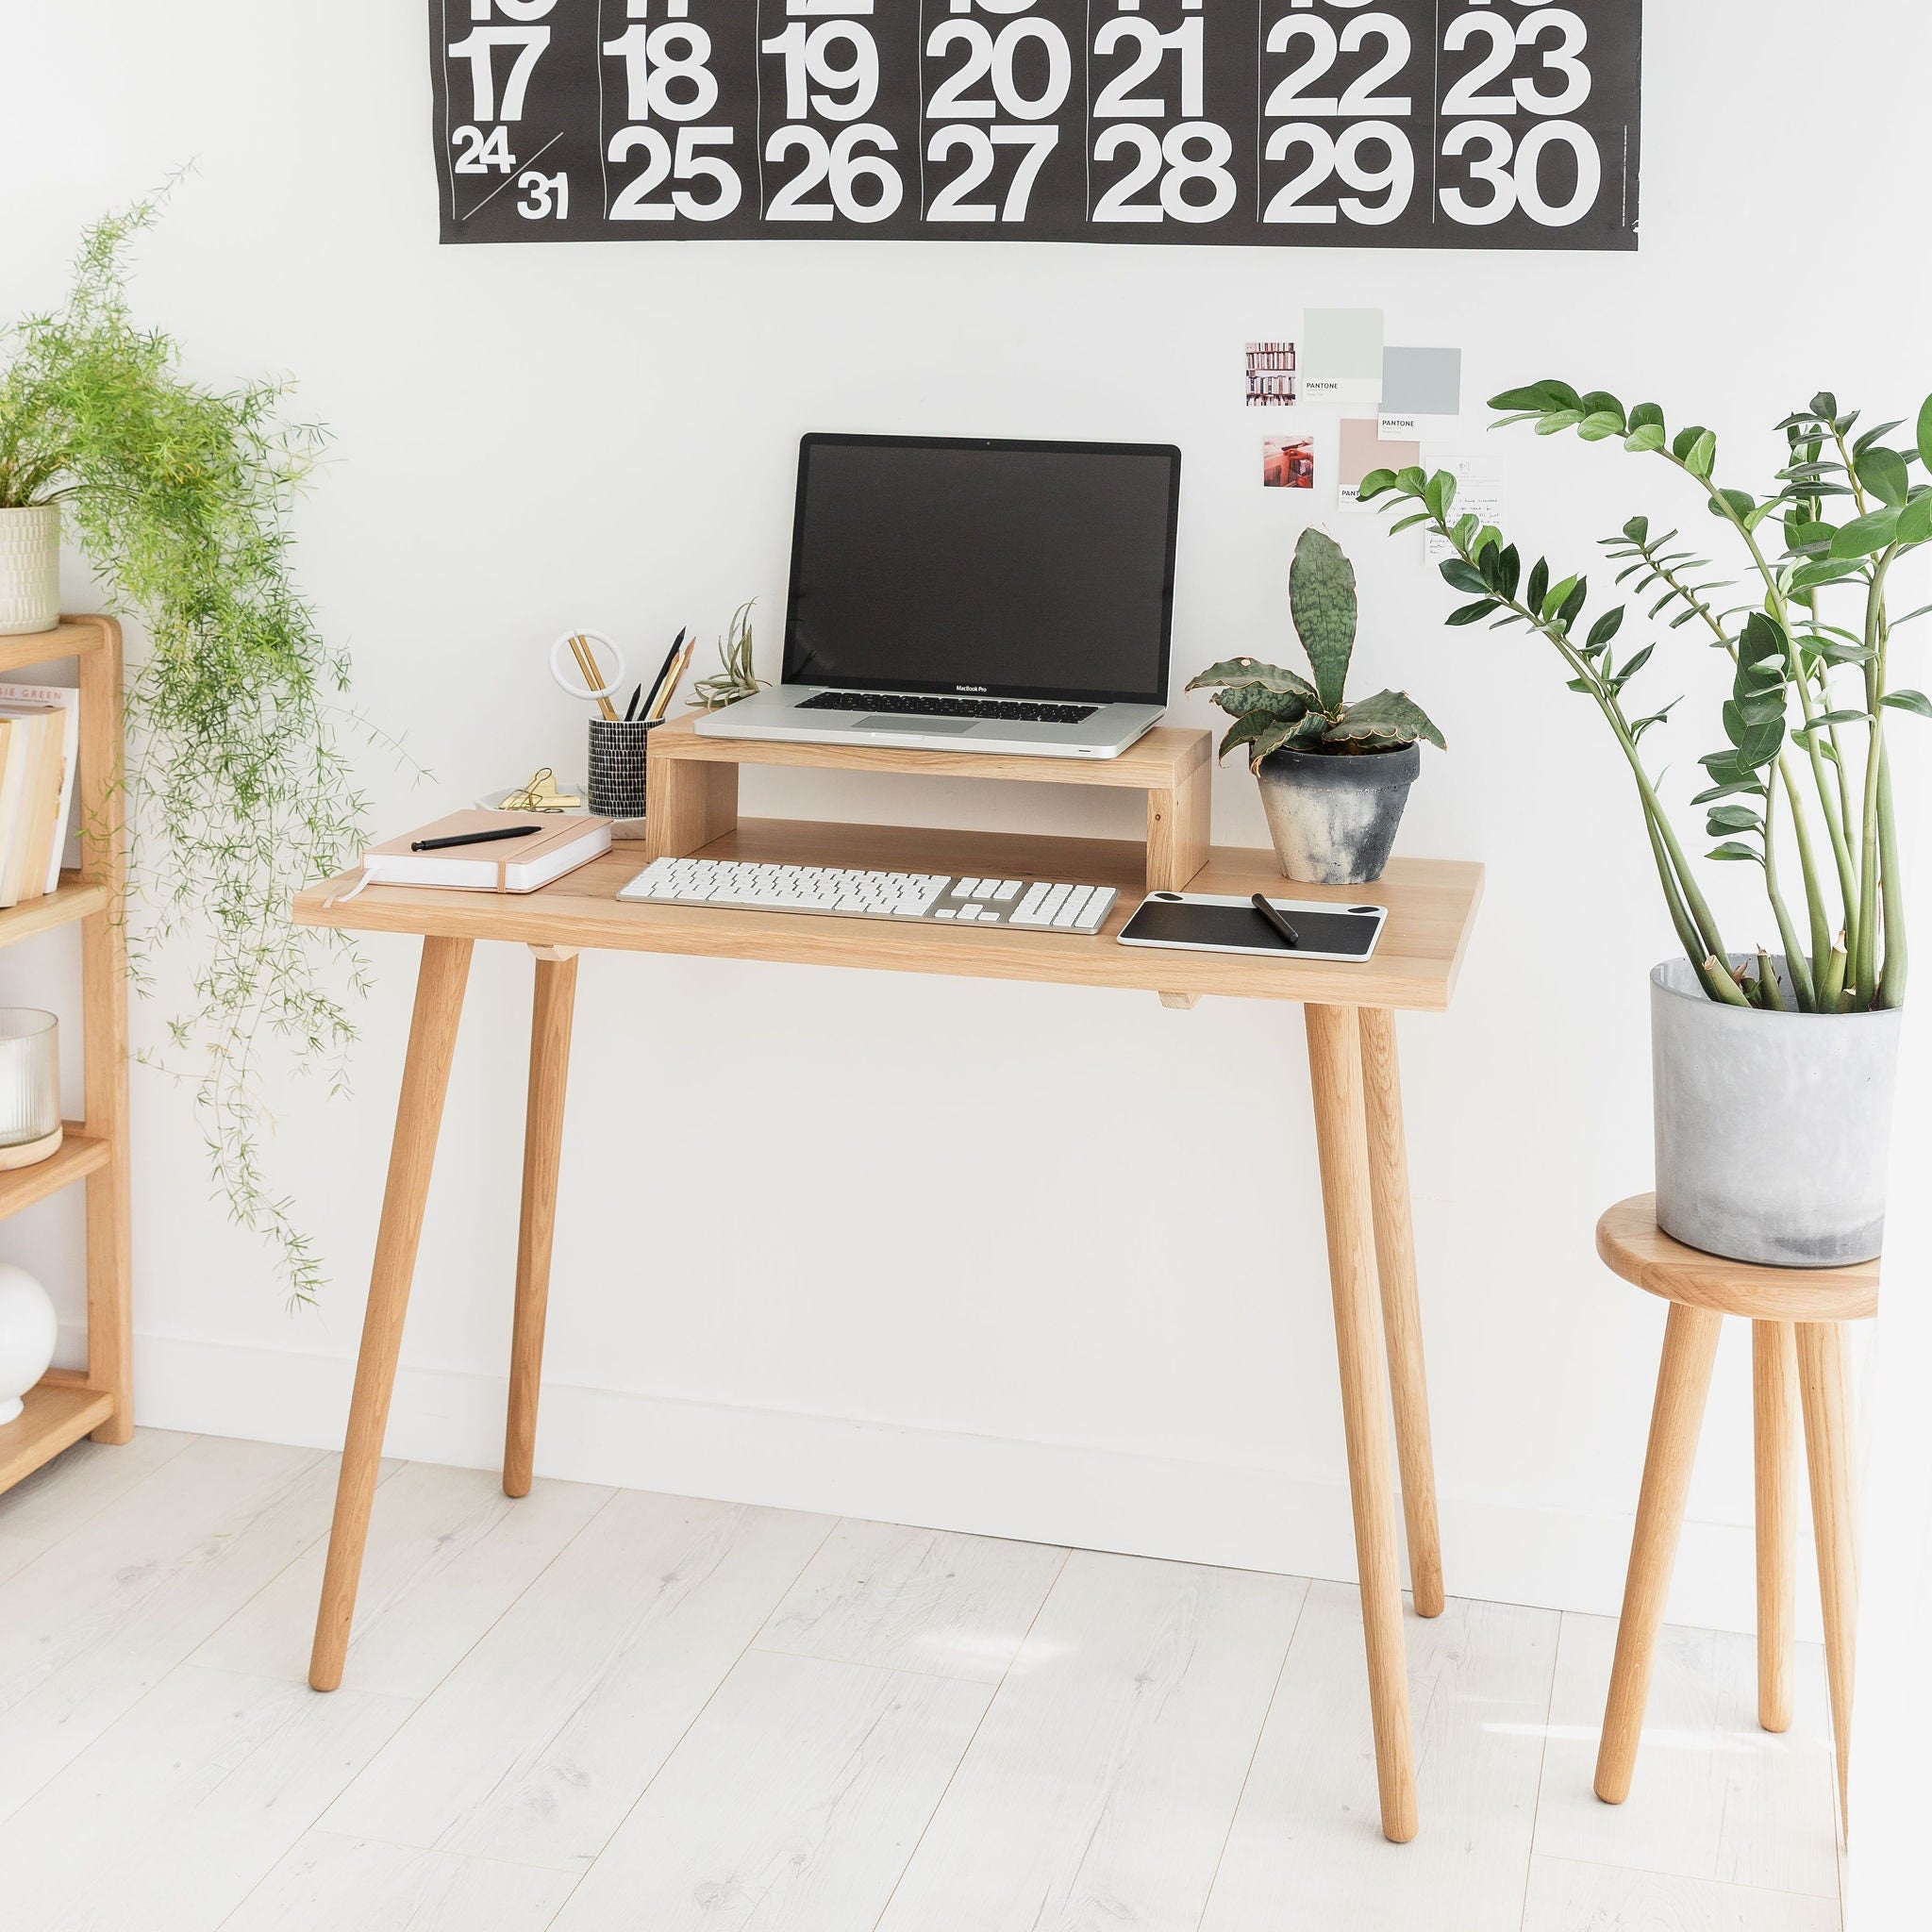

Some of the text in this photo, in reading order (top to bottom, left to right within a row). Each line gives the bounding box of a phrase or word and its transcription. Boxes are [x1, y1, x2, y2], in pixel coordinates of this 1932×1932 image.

[449, 8, 1591, 121] 17 18 19 20 21 22 23
[452, 125, 517, 174] 24
[608, 125, 741, 221] 25
[765, 124, 903, 223] 26
[926, 125, 1058, 222] 27
[1092, 122, 1237, 223] 28
[1263, 121, 1414, 225] 29
[1440, 120, 1601, 226] 30
[518, 172, 568, 219] 31
[22, 689, 61, 699] GREEN
